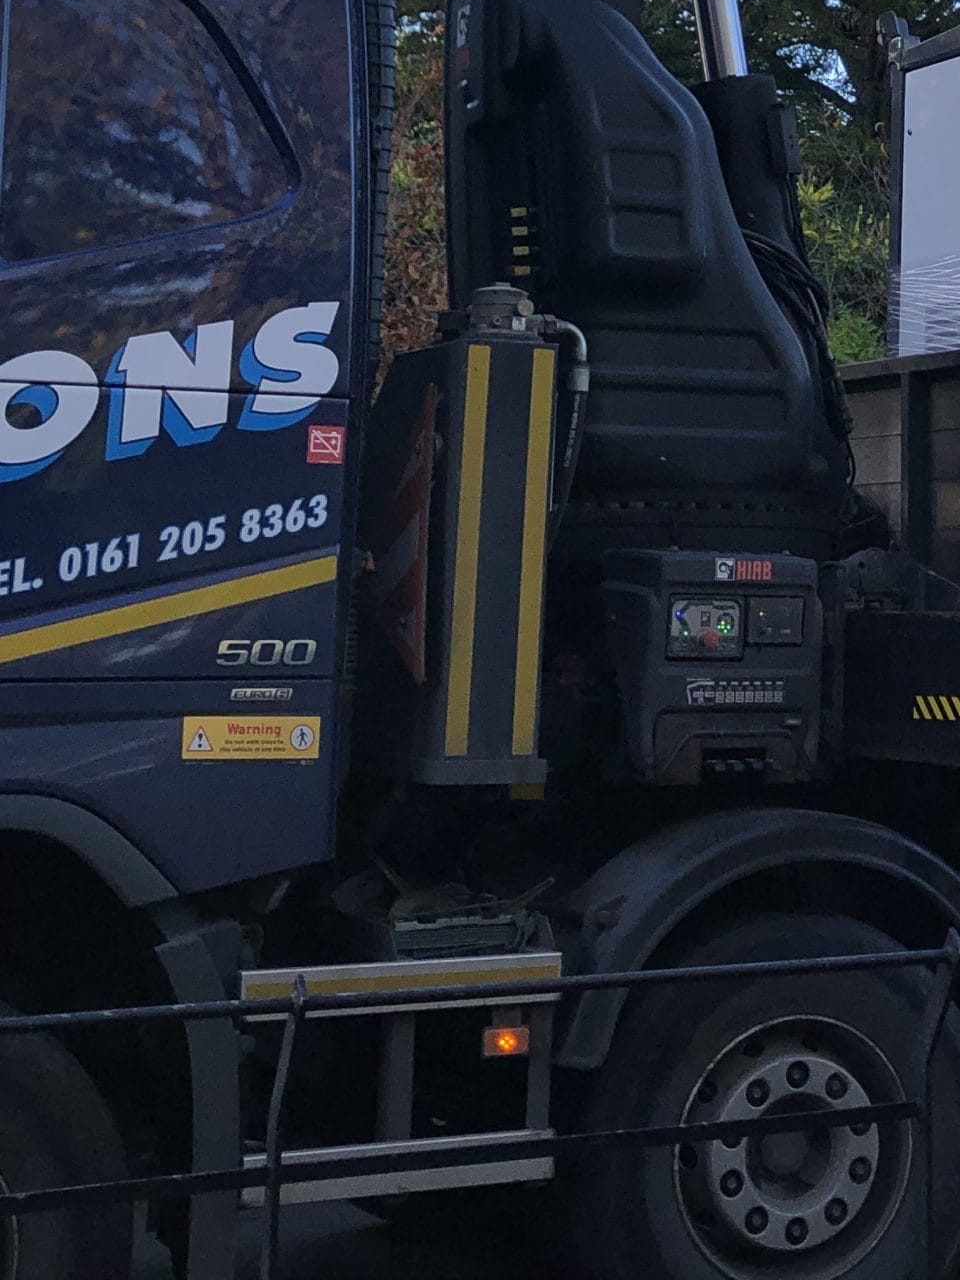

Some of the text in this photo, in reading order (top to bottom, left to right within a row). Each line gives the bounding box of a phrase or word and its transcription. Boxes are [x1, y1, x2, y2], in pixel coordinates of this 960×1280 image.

[0, 301, 340, 476] ONS
[58, 532, 141, 582] 0161
[156, 515, 227, 562] 205
[239, 493, 328, 544] 8363
[736, 560, 773, 581] HIAB
[216, 639, 317, 666] 500
[234, 689, 273, 700] EURO
[227, 722, 282, 737] Warning
